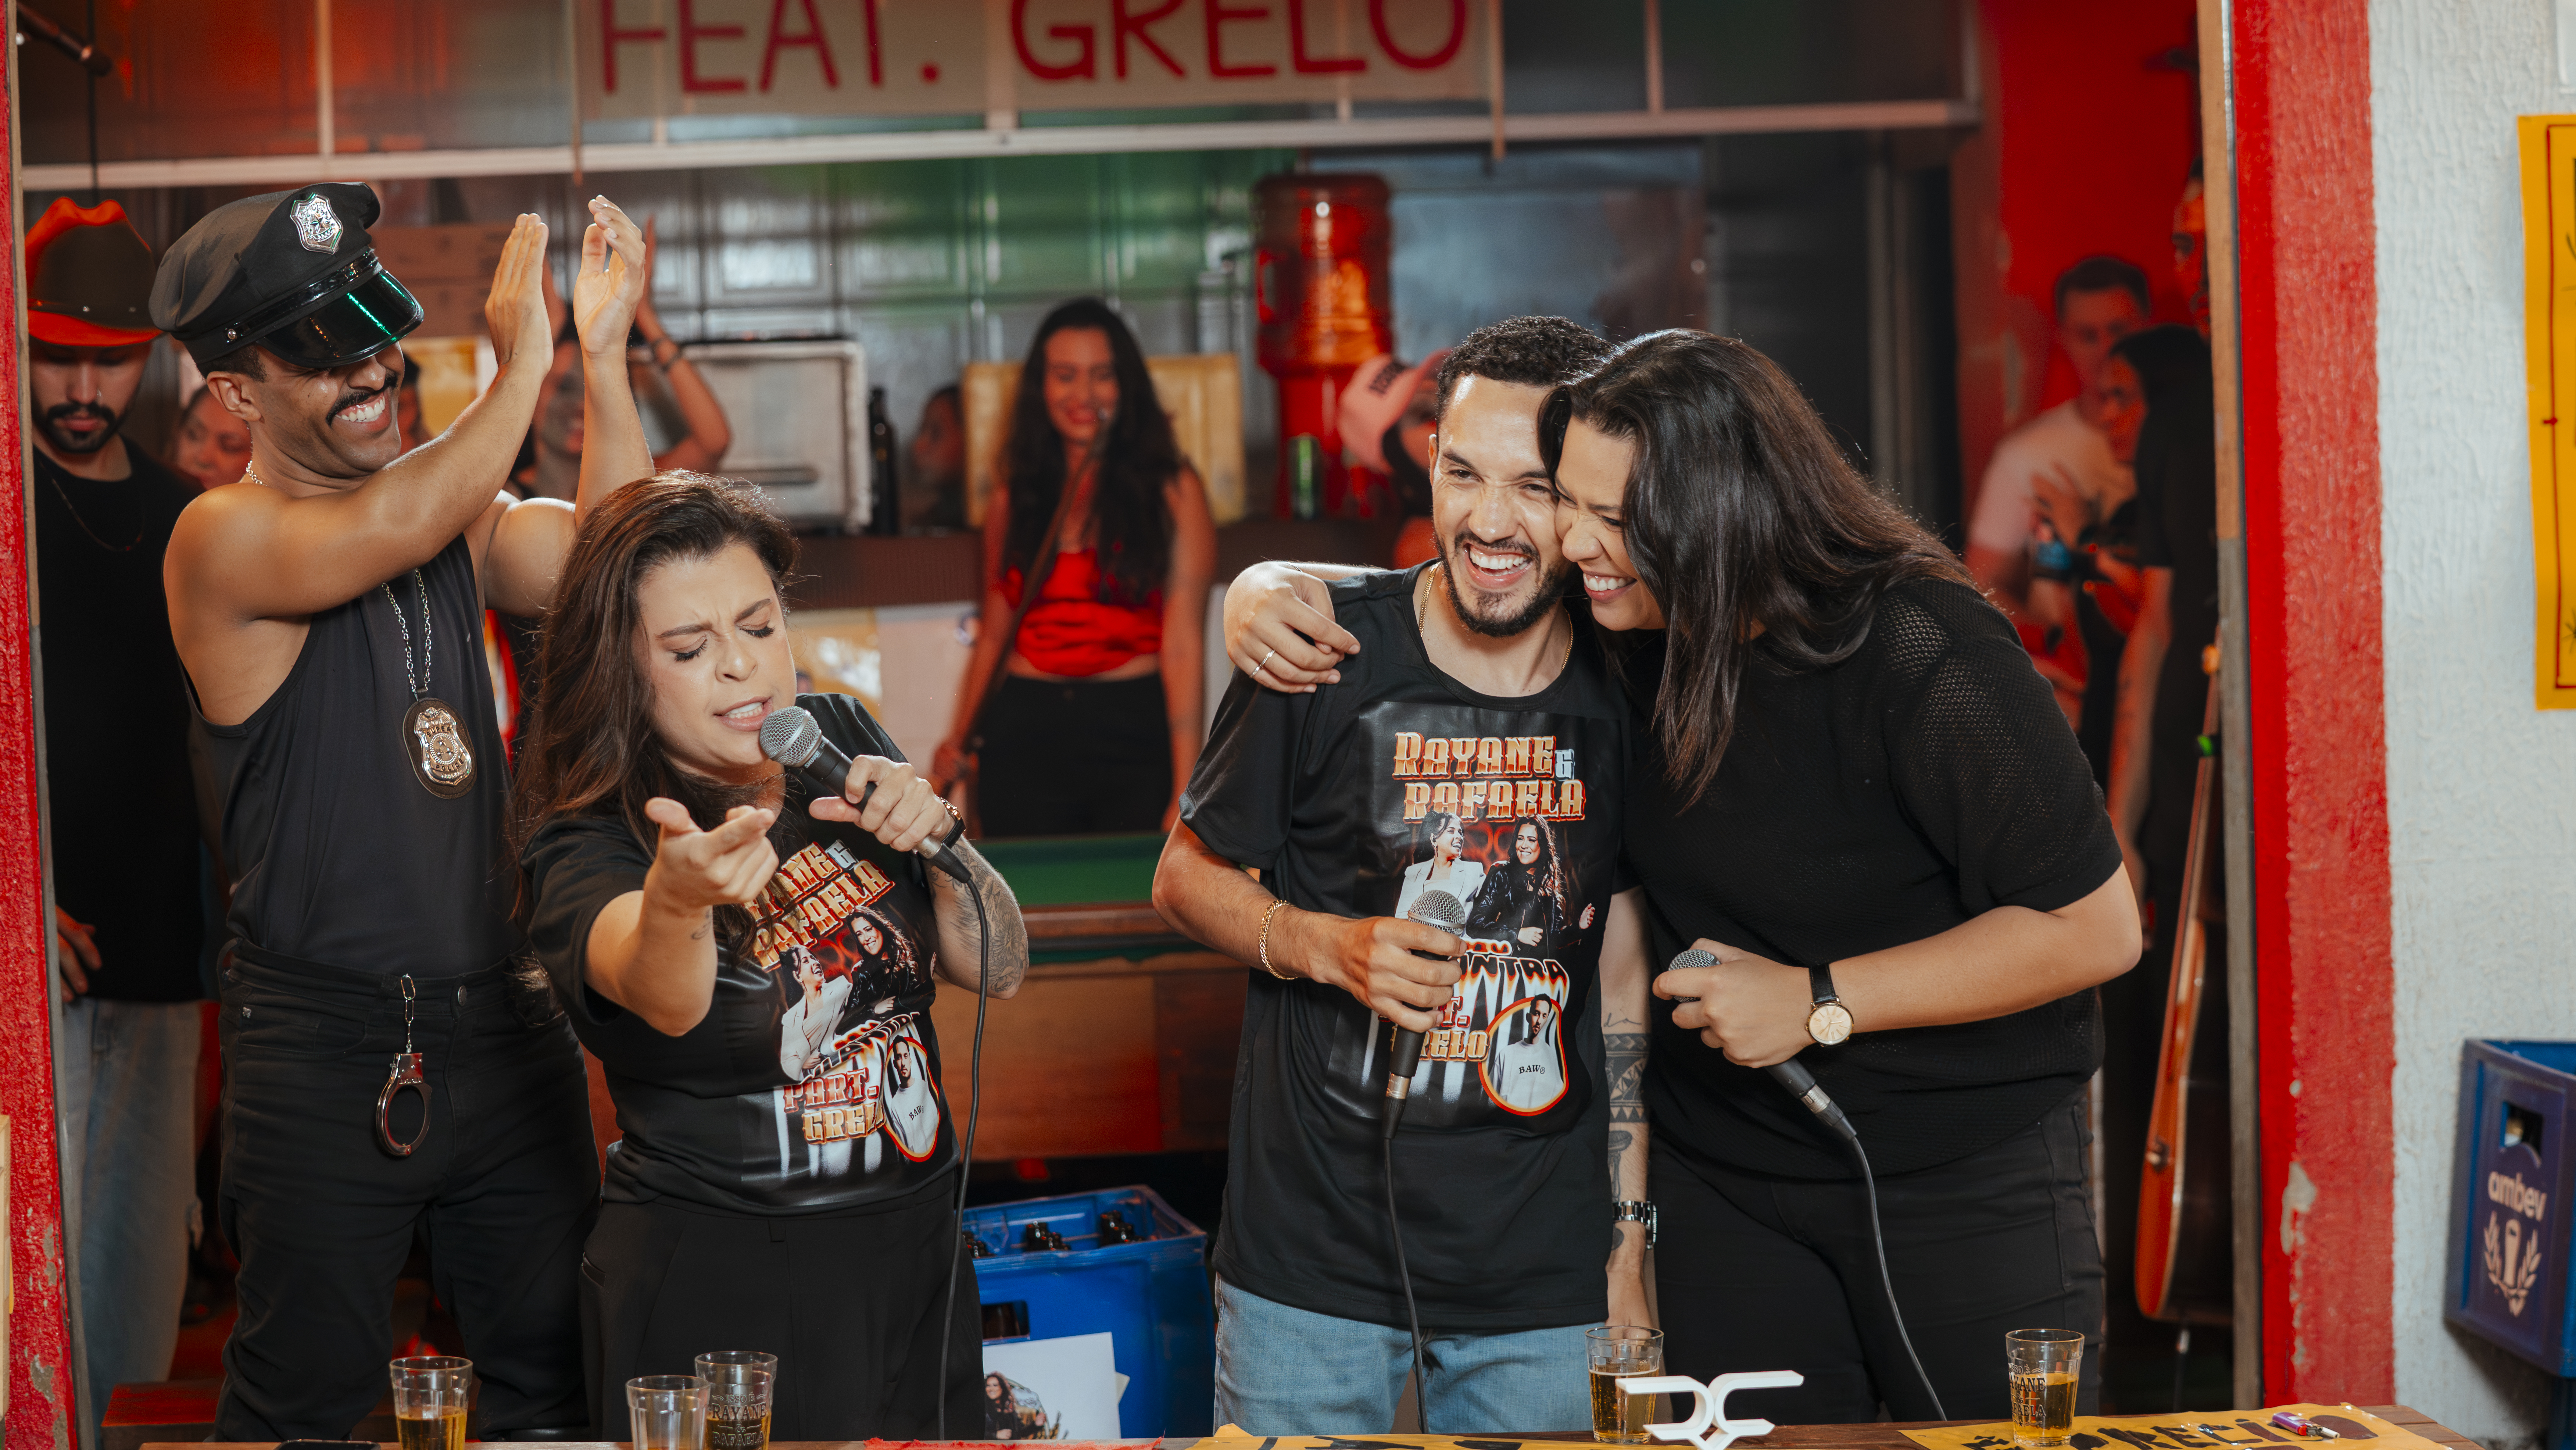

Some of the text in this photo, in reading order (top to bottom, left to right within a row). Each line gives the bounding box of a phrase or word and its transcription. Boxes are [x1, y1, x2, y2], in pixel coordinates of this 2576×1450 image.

[600, 0, 1467, 94] FEAT. GRELO
[426, 725, 451, 737] SUPER
[436, 758, 464, 772] POLICE
[1392, 731, 1557, 780] RAYANE
[1402, 778, 1586, 824] RAFAELA
[754, 859, 896, 974] RAFAELA
[1390, 1028, 1491, 1062] ELO
[783, 1067, 880, 1113] PART.
[2488, 1171, 2548, 1223] ambev
[2009, 1374, 2046, 1392] AYANE
[725, 1394, 747, 1403] ISSO
[712, 1401, 767, 1421] RAYANE
[2011, 1401, 2047, 1417] FAELA
[735, 1424, 746, 1433] &
[712, 1431, 765, 1447] RAFAELA
